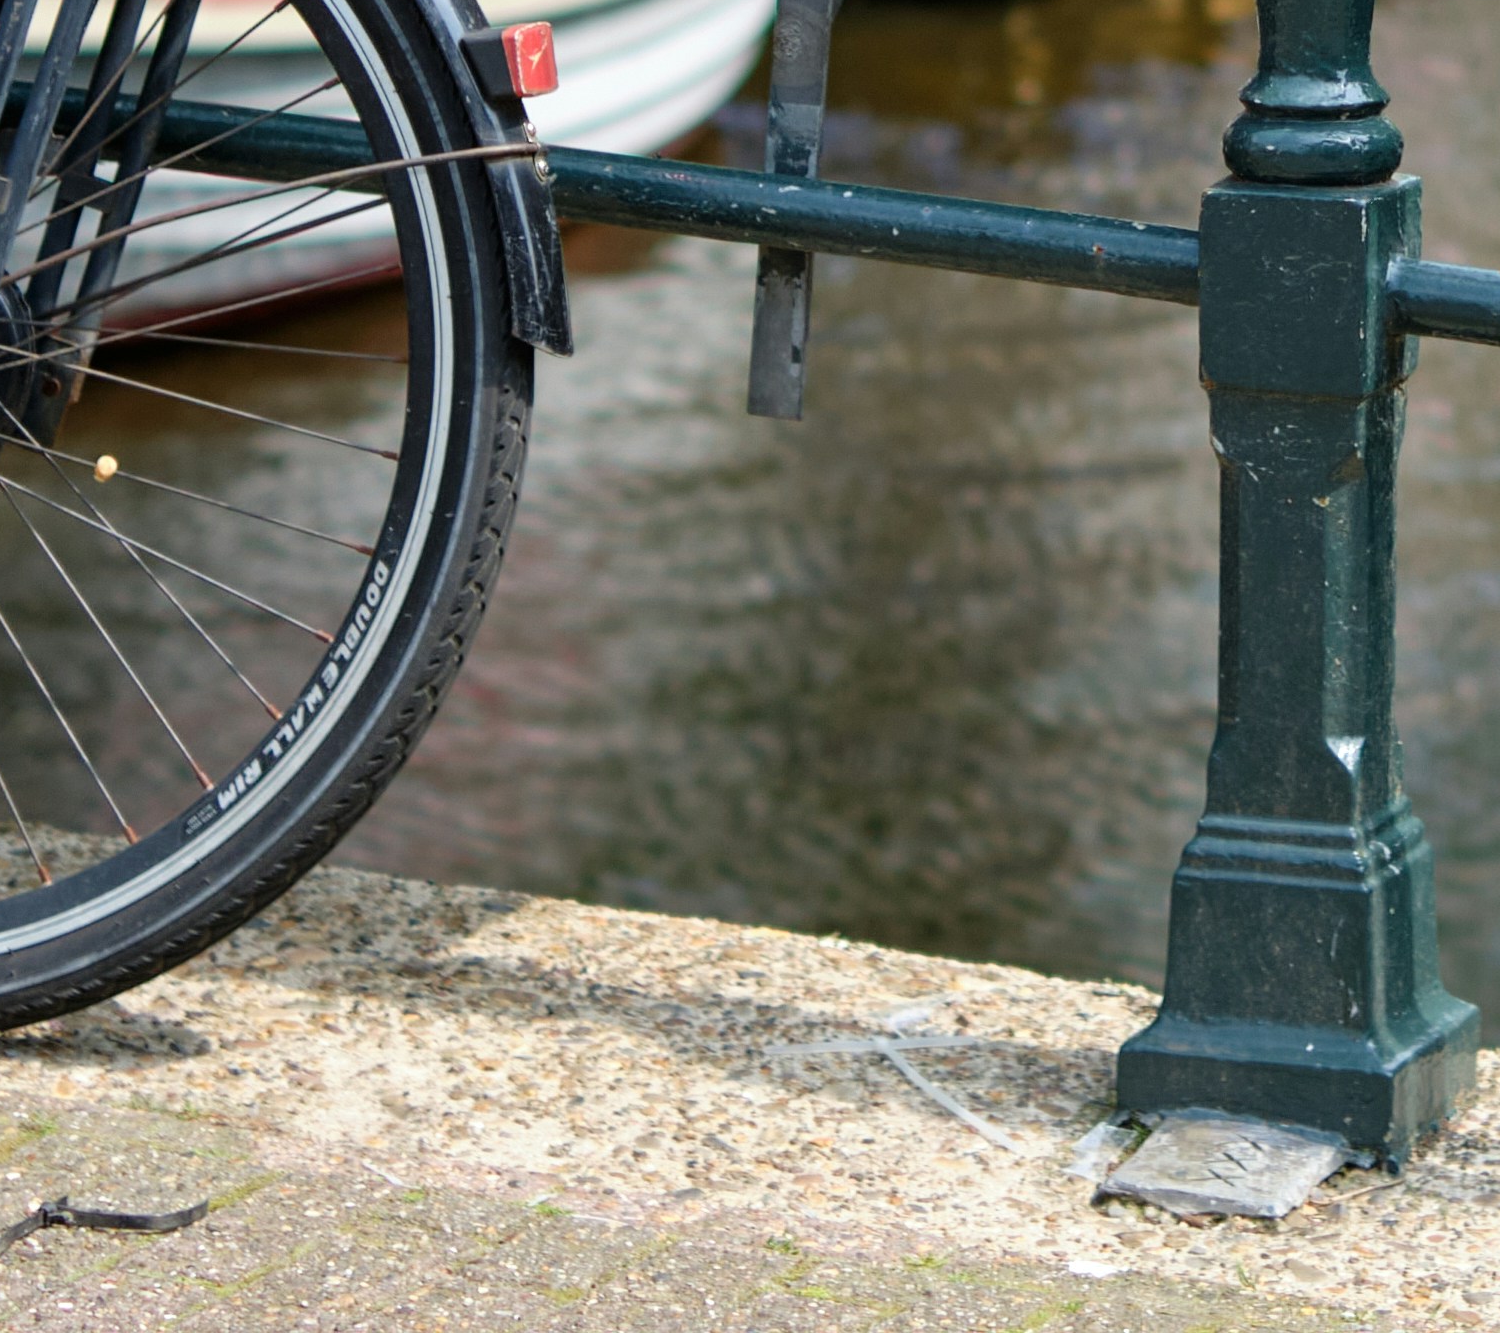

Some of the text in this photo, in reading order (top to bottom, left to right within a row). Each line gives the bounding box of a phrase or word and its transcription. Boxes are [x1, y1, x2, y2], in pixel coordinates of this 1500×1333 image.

[217, 560, 389, 810] DOUBLE WALL RIM
